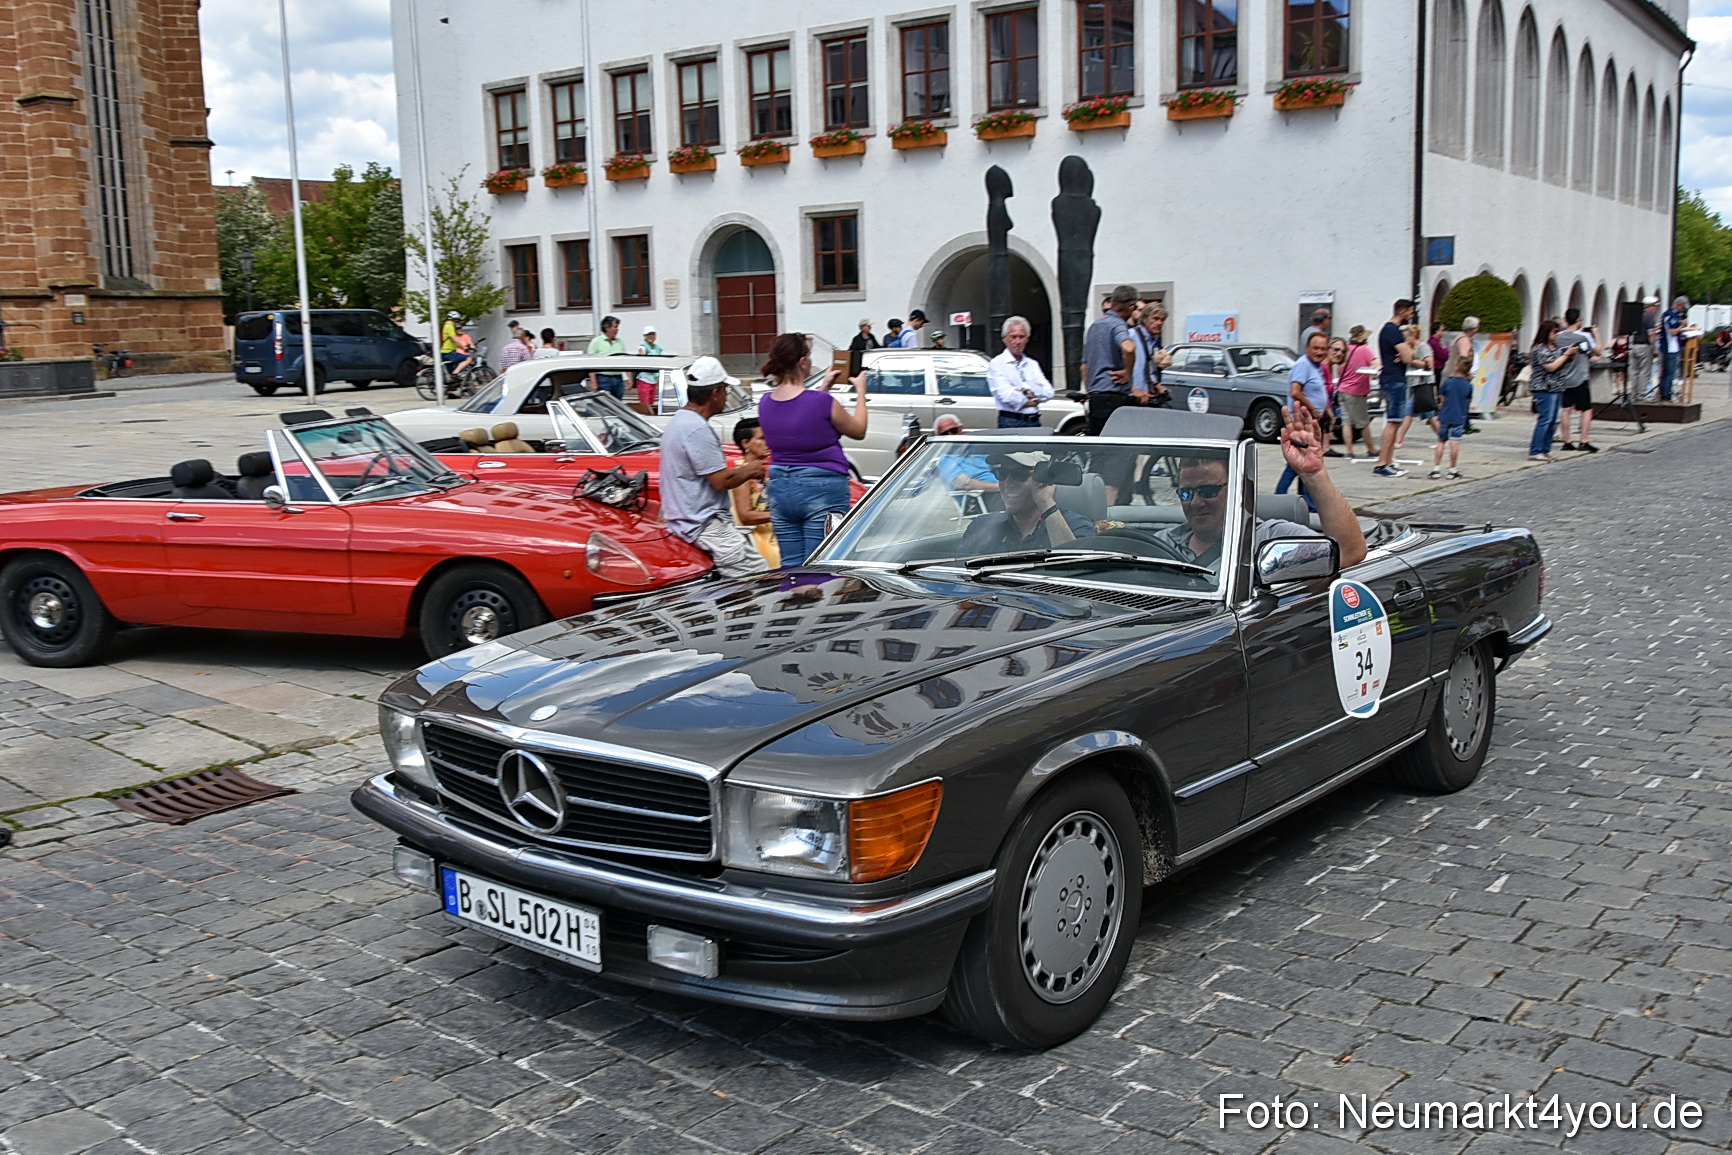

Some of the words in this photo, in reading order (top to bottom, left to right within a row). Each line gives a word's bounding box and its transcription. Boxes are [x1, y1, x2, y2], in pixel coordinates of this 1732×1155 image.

[1188, 331, 1222, 342] Kunst
[1355, 647, 1373, 681] 34
[458, 878, 472, 914] B
